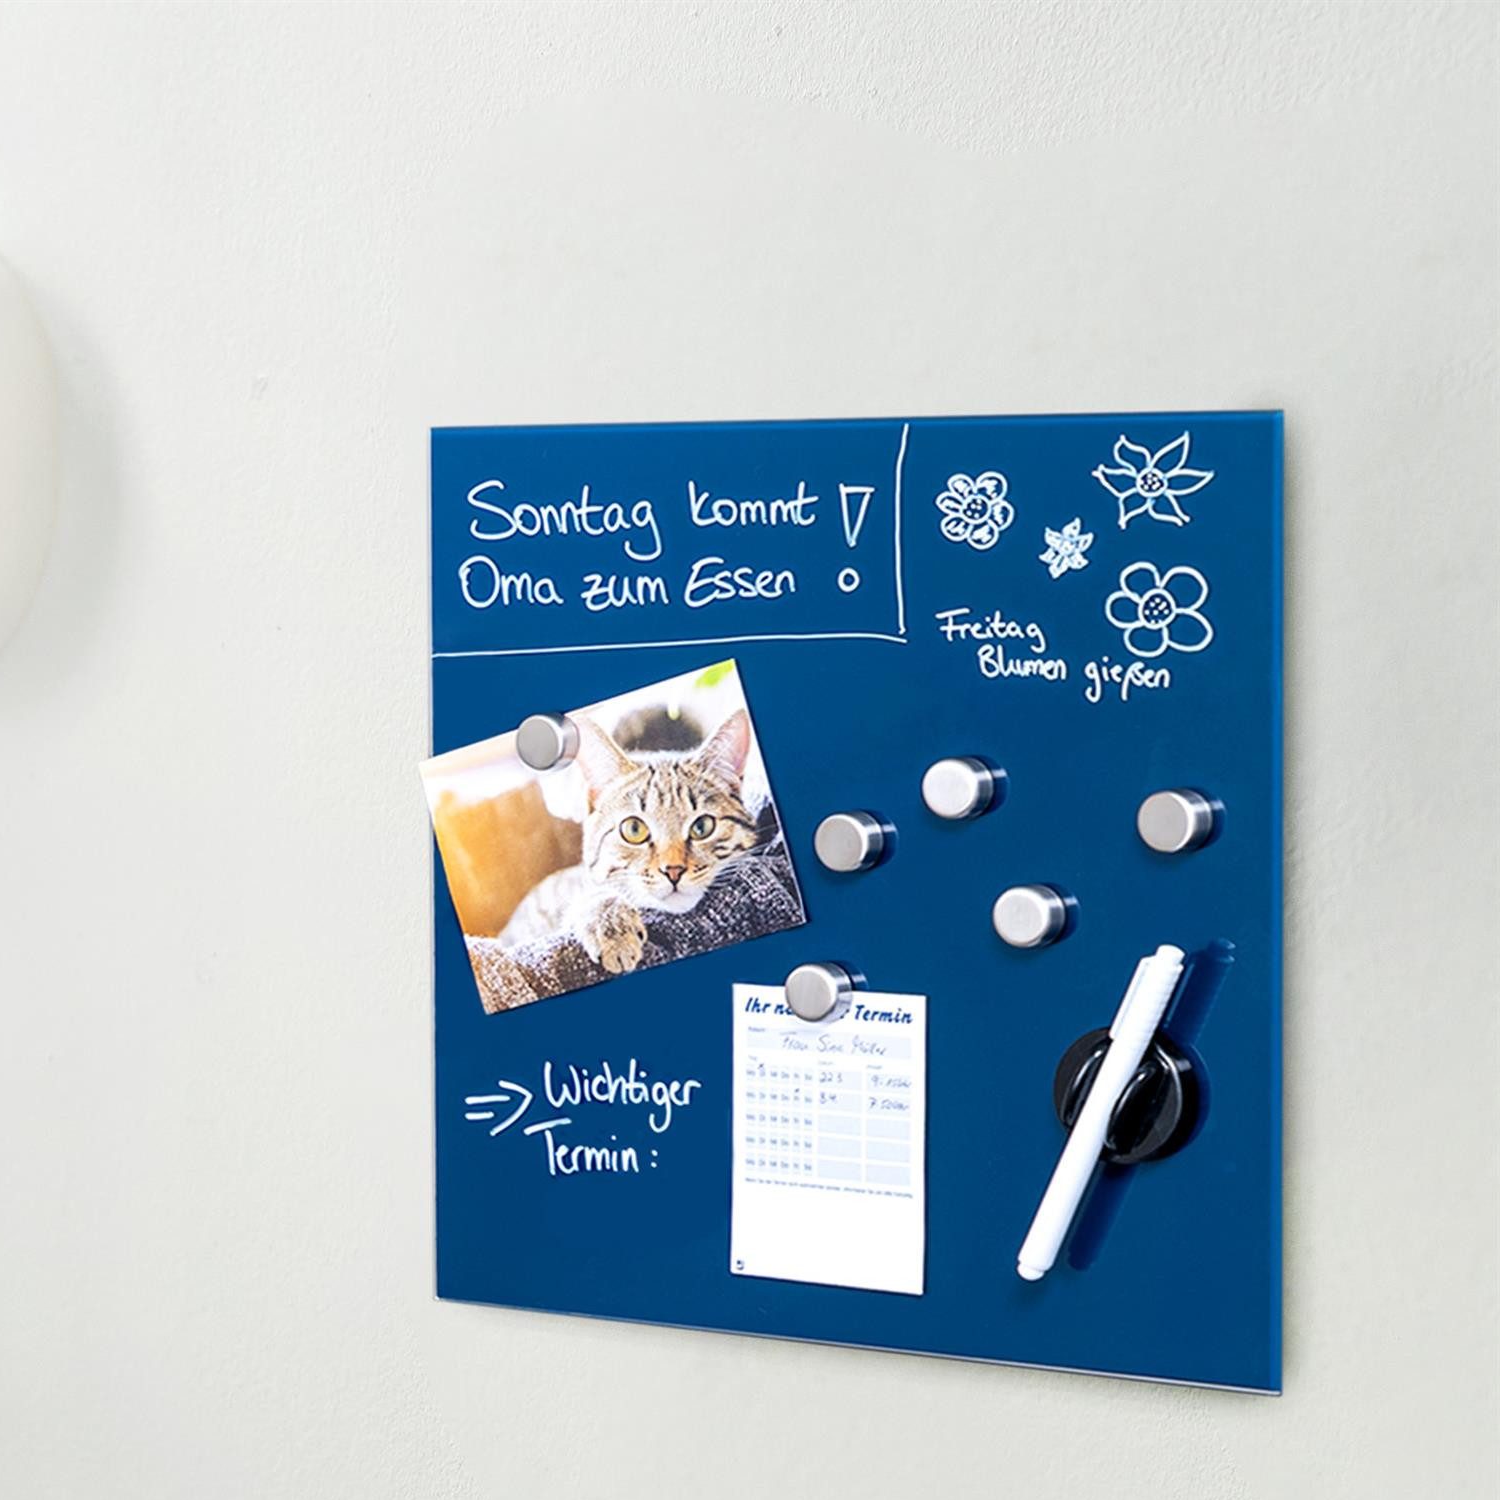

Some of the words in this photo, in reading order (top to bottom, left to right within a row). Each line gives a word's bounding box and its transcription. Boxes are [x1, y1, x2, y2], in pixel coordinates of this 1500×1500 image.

[466, 479, 663, 562] Sonntag
[688, 480, 819, 527] kommt
[458, 555, 564, 609] Oma
[580, 573, 669, 611] zum
[683, 556, 796, 608] Essen
[934, 607, 1046, 653] Freitag
[977, 644, 1067, 680] Blumen
[1084, 656, 1171, 703] gießen
[744, 997, 771, 1014] Ihr
[853, 1004, 913, 1025] Termin
[543, 1058, 702, 1134] Wichtiger
